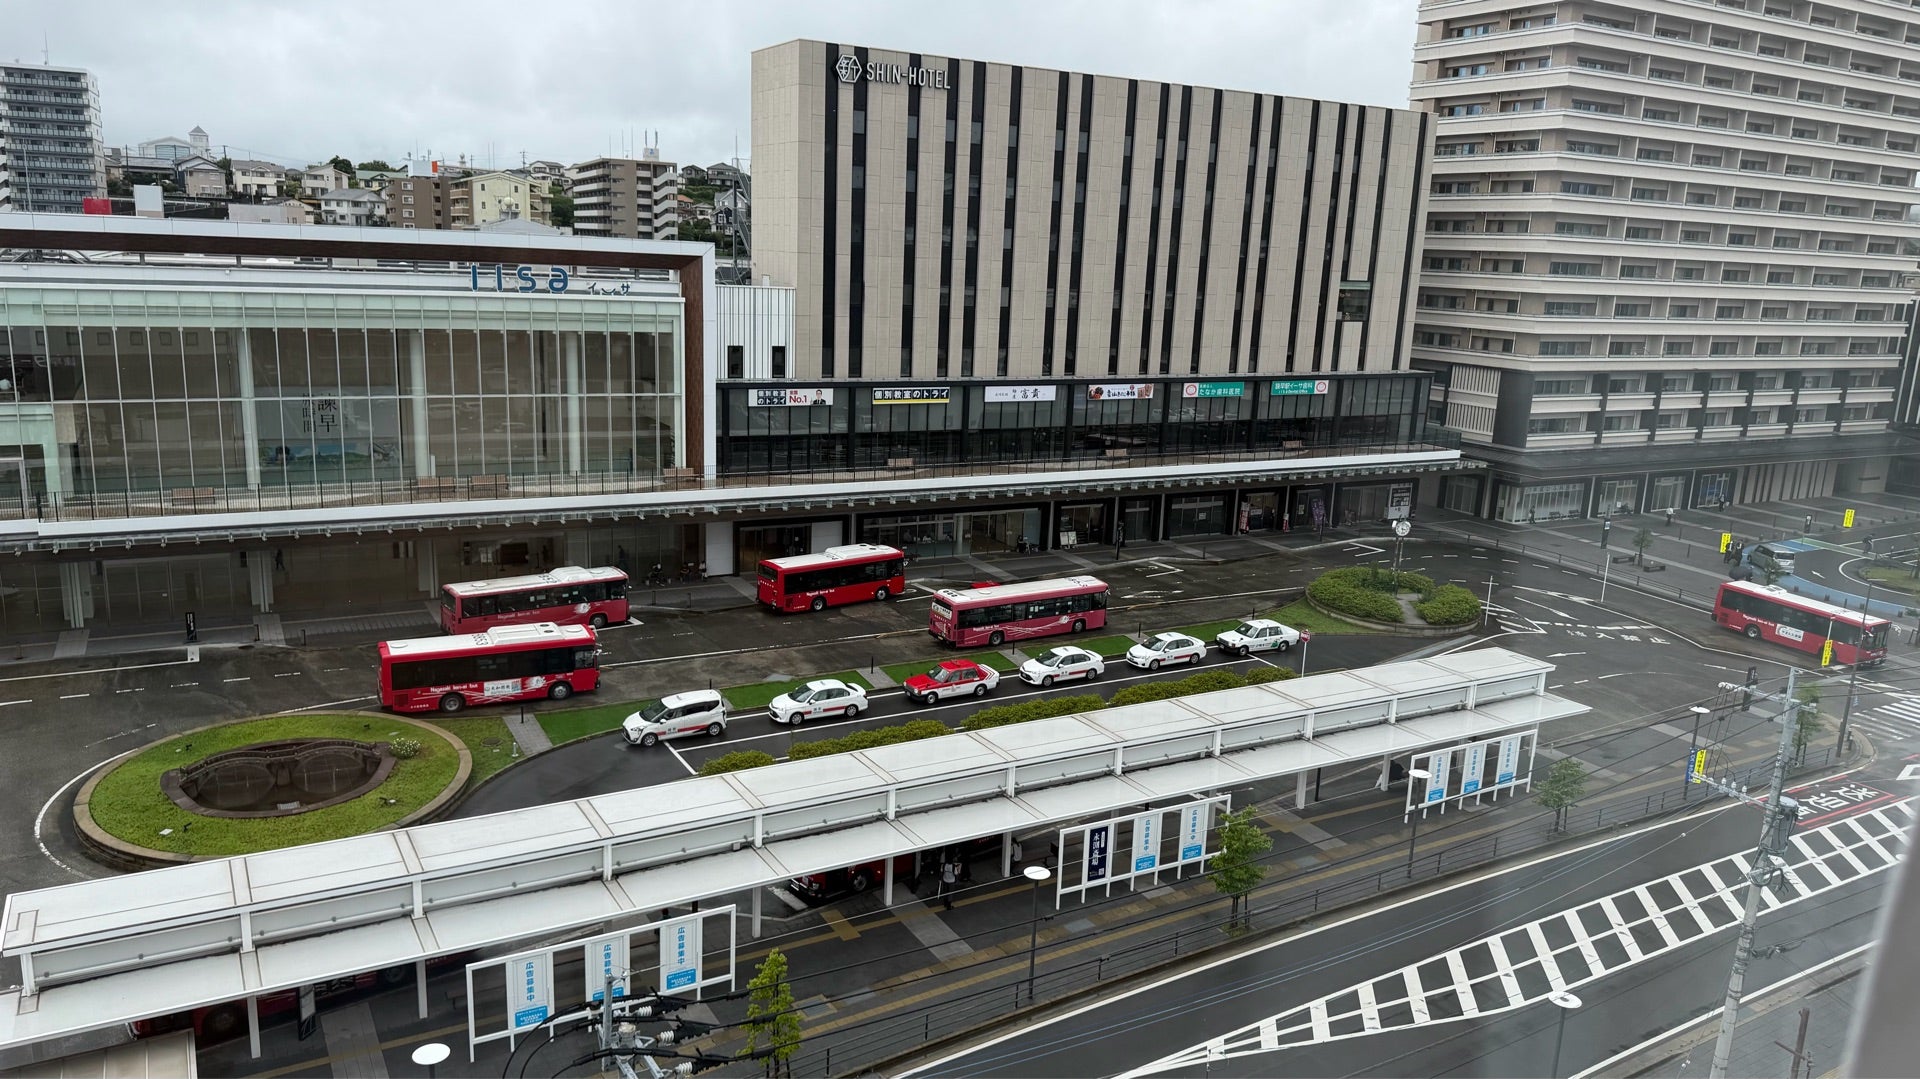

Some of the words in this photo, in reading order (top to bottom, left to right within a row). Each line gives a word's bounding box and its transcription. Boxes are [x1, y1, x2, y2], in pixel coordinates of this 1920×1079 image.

[866, 62, 950, 89] SHIN-HOTEL
[789, 395, 807, 403] No.1
[874, 390, 948, 399] 個別教室のトライ
[1020, 388, 1040, 399] 富貴
[318, 393, 337, 432] 諫早
[526, 962, 535, 1002] 広告募集中
